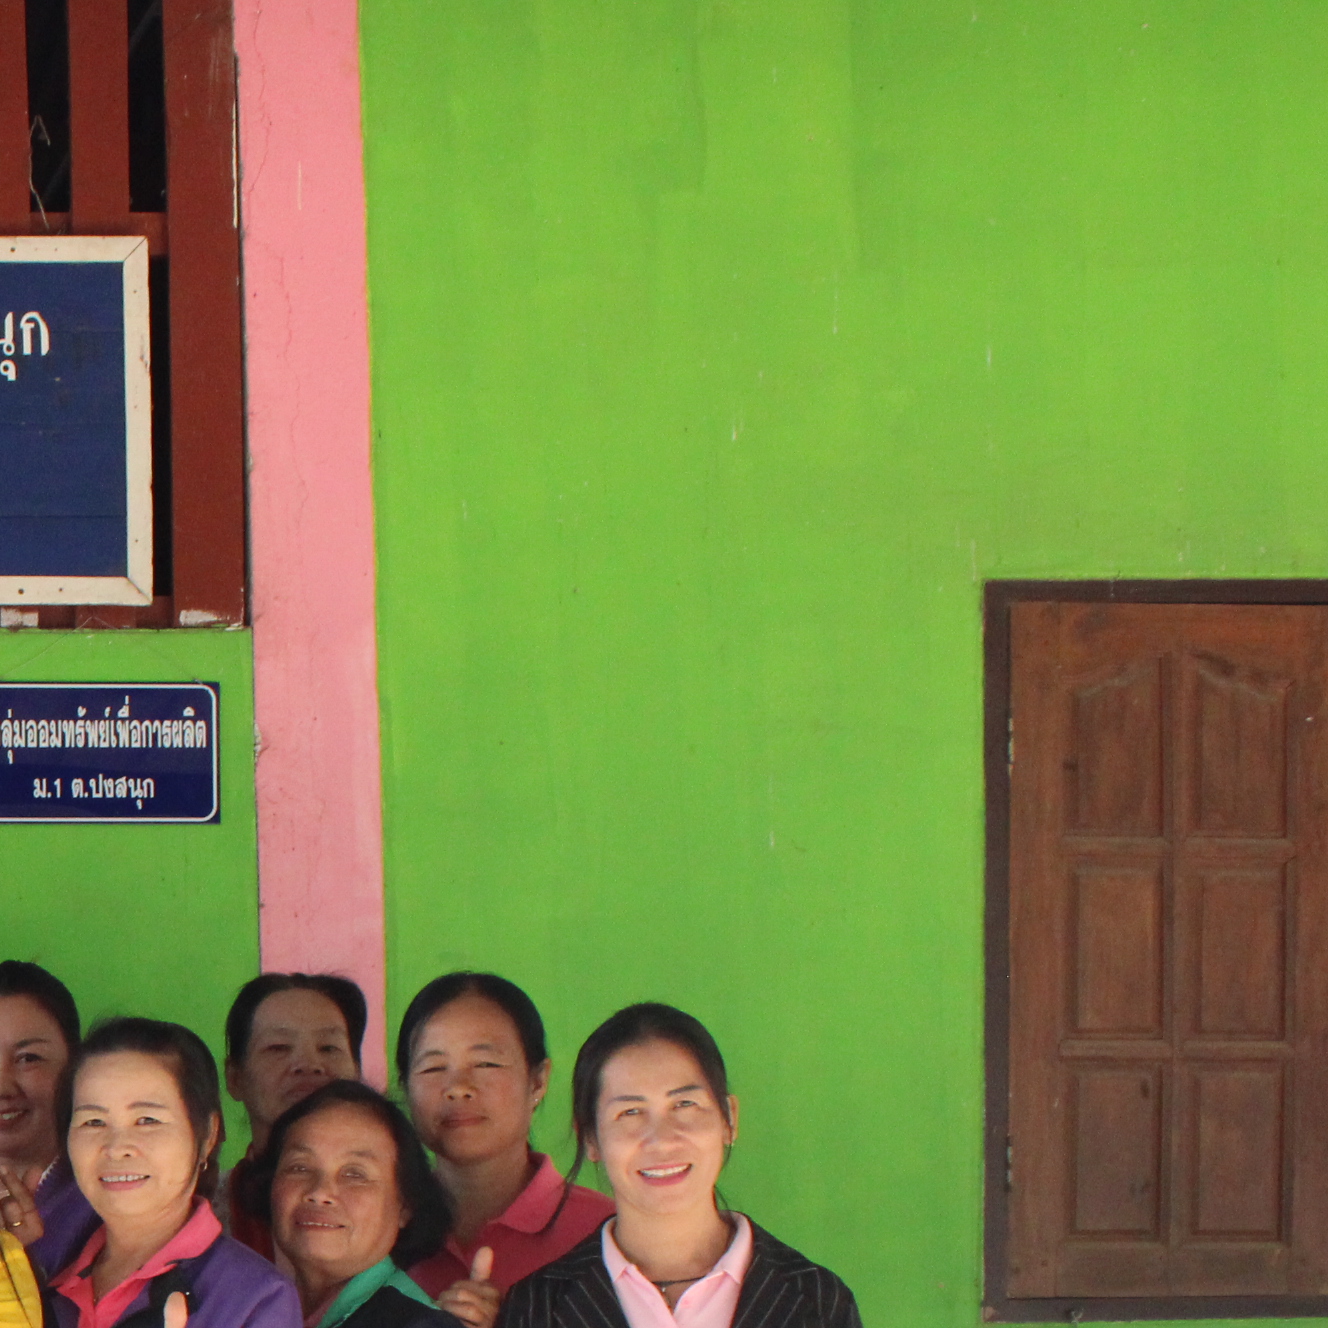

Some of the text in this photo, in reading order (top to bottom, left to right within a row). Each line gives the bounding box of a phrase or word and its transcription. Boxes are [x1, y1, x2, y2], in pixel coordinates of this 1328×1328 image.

[33, 773, 155, 811] ม.1 ต.ปงสนุก
